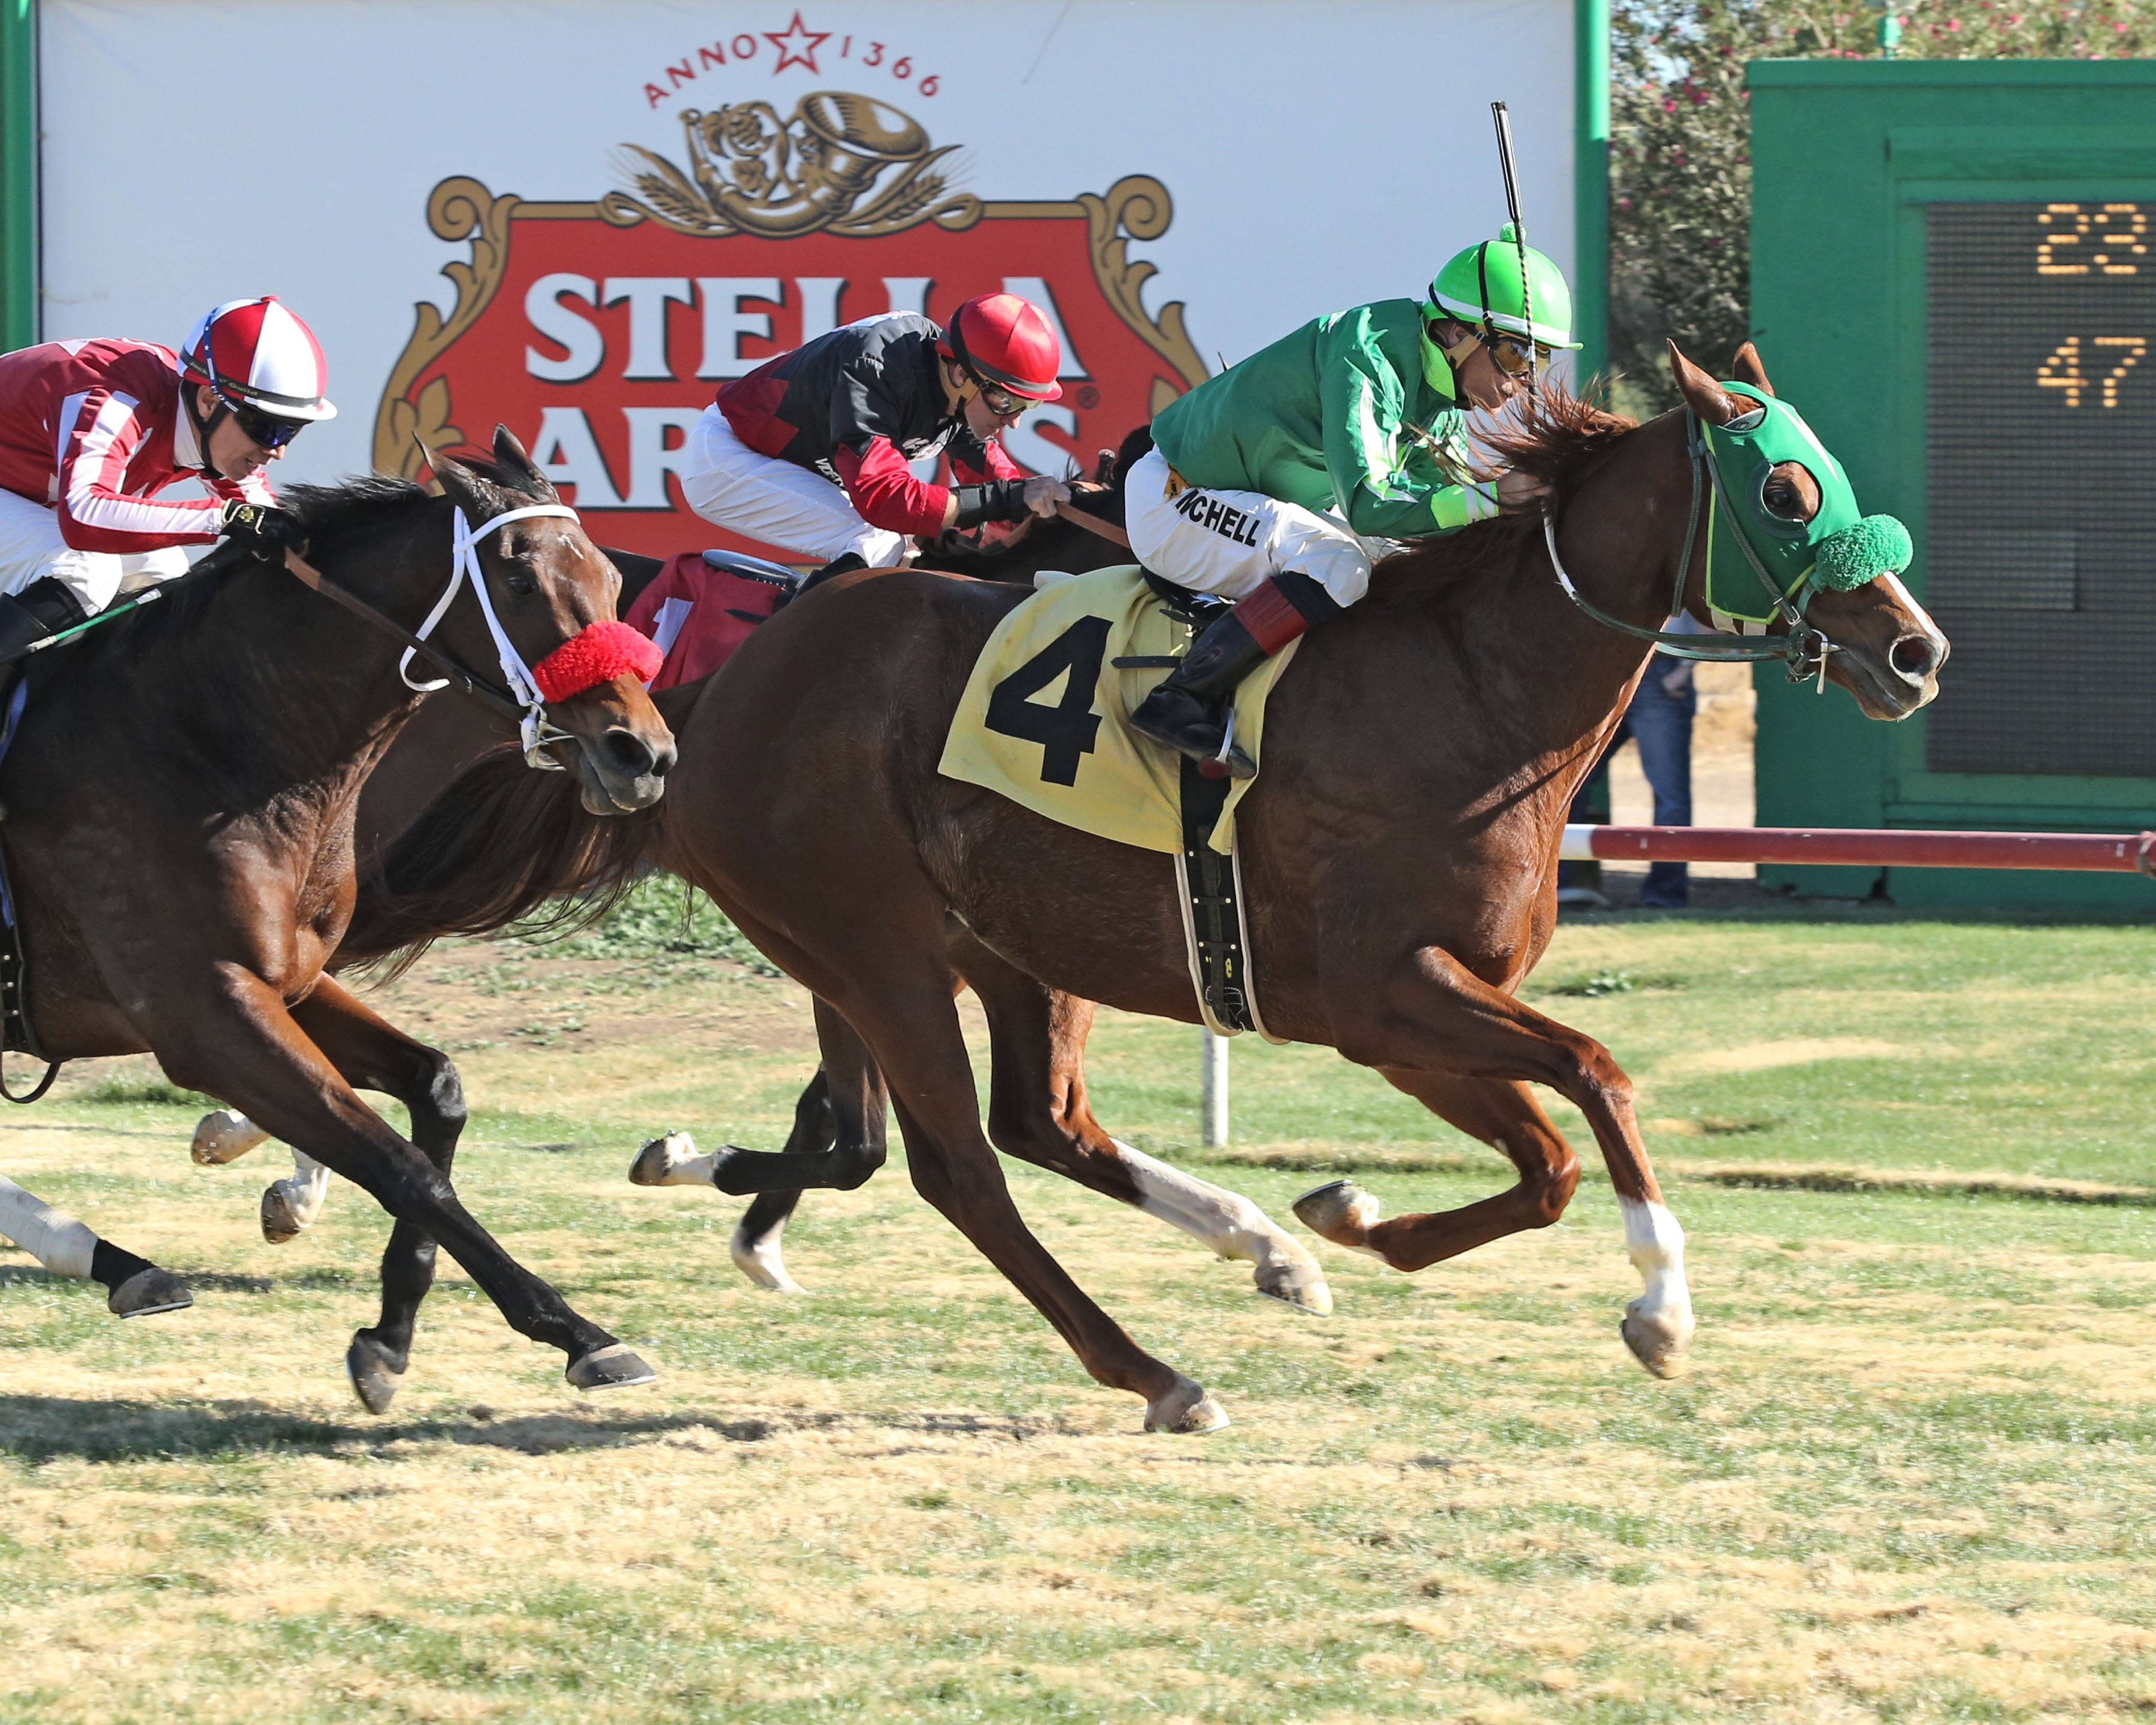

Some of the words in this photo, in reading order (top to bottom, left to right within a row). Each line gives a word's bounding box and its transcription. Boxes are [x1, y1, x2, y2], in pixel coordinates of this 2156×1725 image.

[644, 34, 758, 110] ANNO
[840, 35, 941, 97] 1366
[2037, 203, 2148, 275] 23
[2037, 336, 2147, 408] 47
[530, 402, 1084, 510] ARS
[984, 614, 1114, 788] 4
